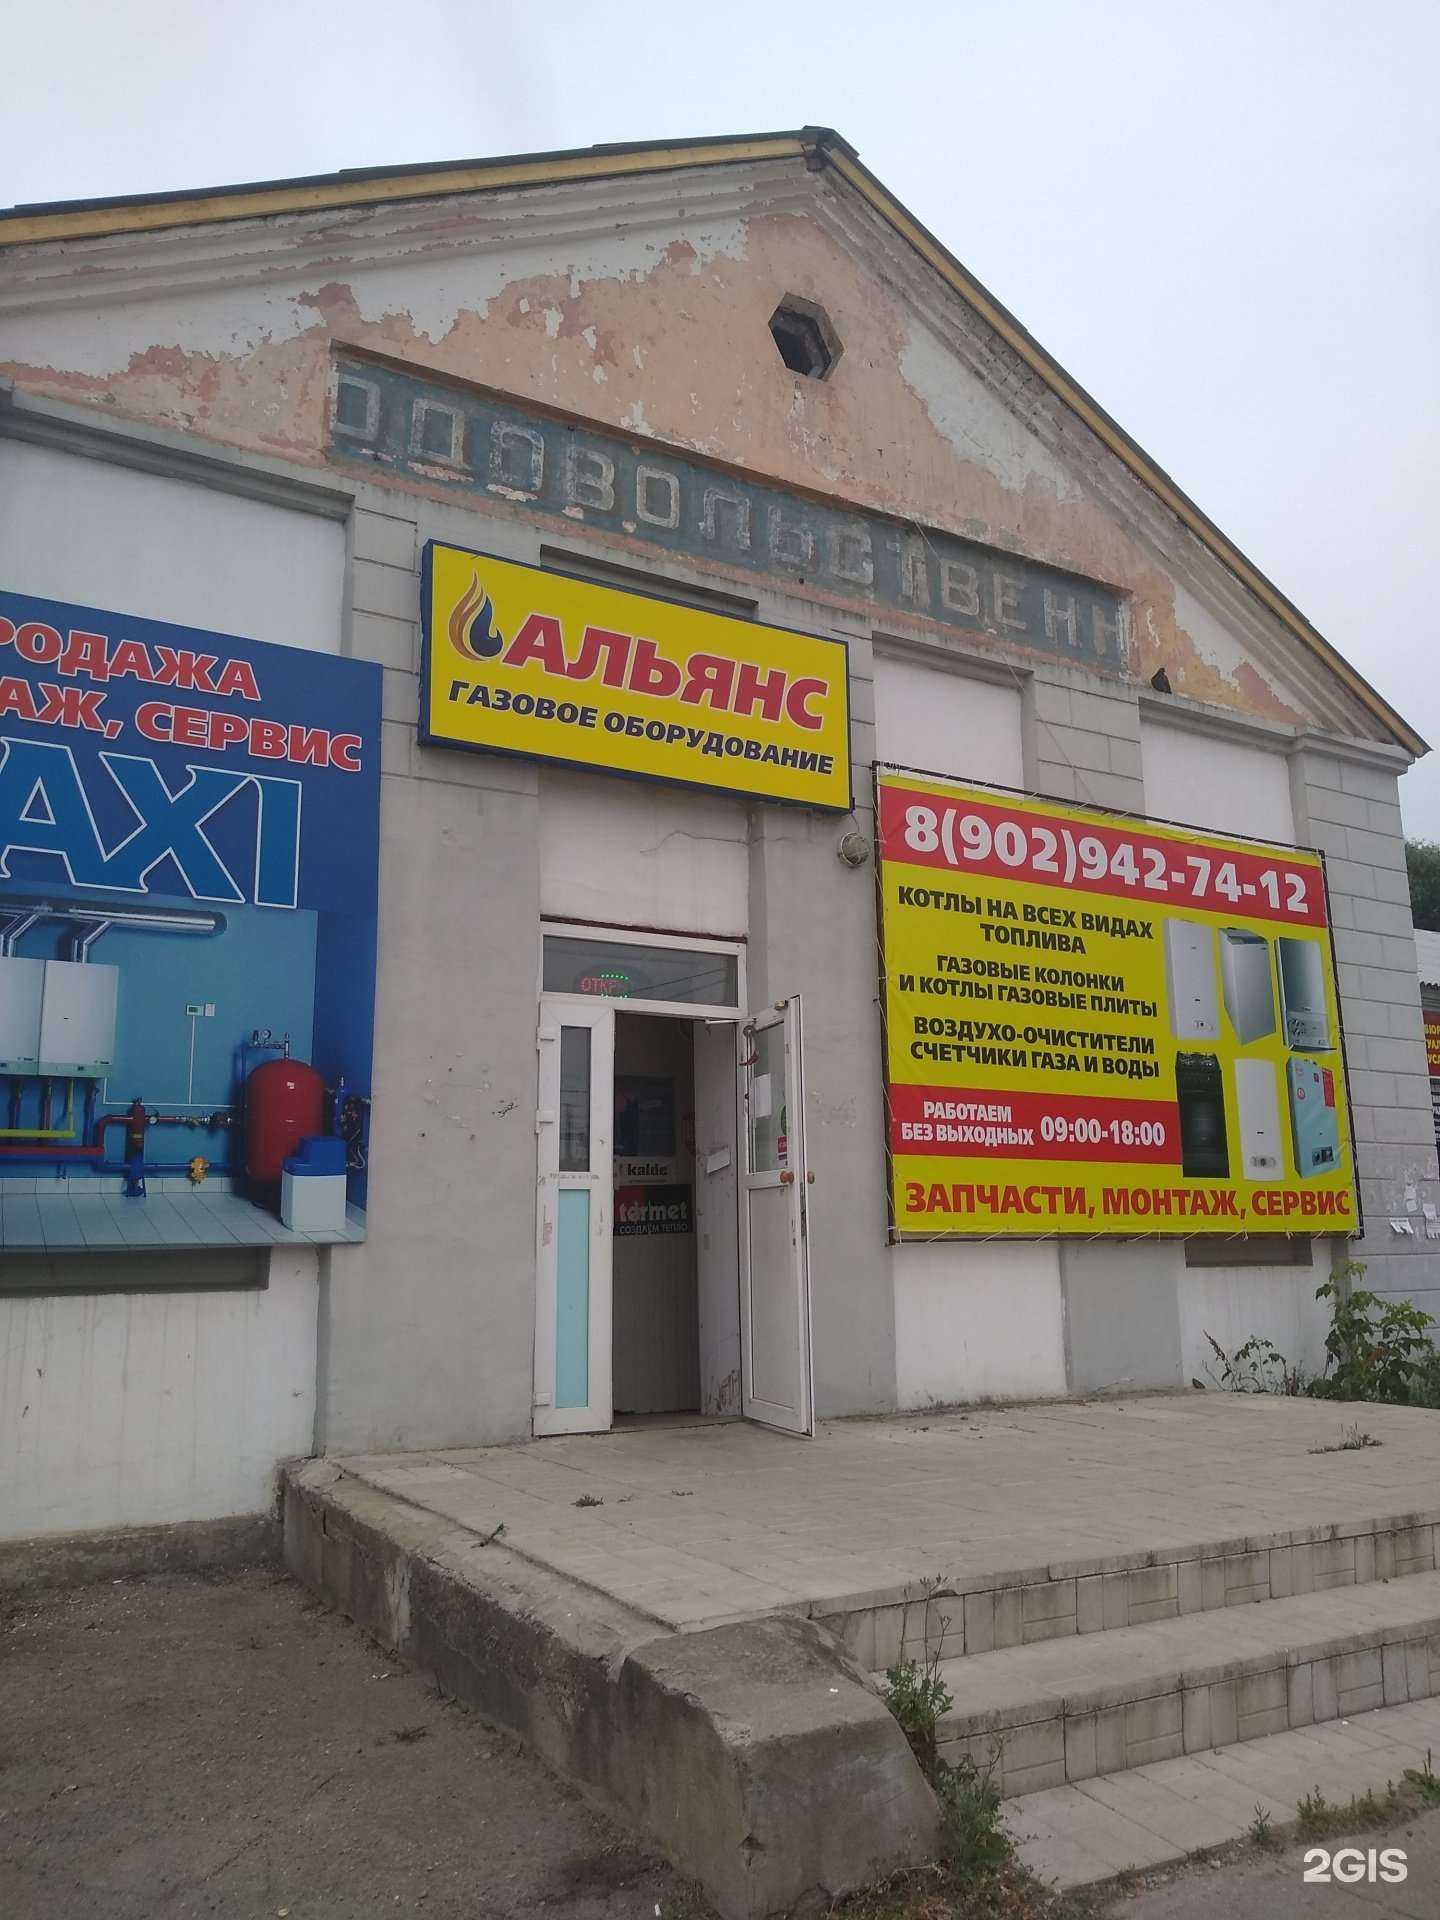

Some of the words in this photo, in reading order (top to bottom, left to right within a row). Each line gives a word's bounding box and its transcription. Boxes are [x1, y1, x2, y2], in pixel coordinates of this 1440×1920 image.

[502, 612, 829, 732] АЛЬЯНС
[134, 701, 362, 772] СЕРВИС
[448, 679, 598, 729] ГАЗОВОЕ
[604, 711, 835, 776] ОБОРУДОВАНИЕ
[903, 804, 1309, 914] 8(902)942-74-12
[897, 885, 982, 915] КОТЛЫ
[987, 894, 1019, 921] НА
[1022, 903, 1077, 930] ВСЕХ
[1081, 914, 1154, 940] ВИДАХ
[979, 922, 1087, 955] ТОПЛИВА
[936, 954, 1030, 983] ГАЗОВЫЕ
[1034, 965, 1125, 993] КОЛОНКИ
[899, 973, 915, 992] И
[919, 974, 994, 1001] КОТЛЫ
[997, 984, 1087, 1010] ГАЗОВЫЕ
[1091, 992, 1158, 1018] ПЛИТЫ
[913, 1015, 1155, 1055] ВОЗДУХО-ОЧИСТИТЕЛИ
[910, 1040, 1024, 1069] СЧЕТЧИКИ
[1030, 1052, 1080, 1075] ГАЗА
[1084, 1056, 1098, 1074] И
[1102, 1058, 1160, 1080] ВОДЫ
[923, 1100, 1012, 1123] РАБОТАЕМ
[1040, 1115, 1166, 1147] 09:00-18:00
[901, 1121, 934, 1142] БЕЗ
[936, 1124, 1034, 1147] ВЫХОДНЫХ
[618, 1202, 688, 1220] termet
[905, 1182, 1095, 1219] ЗАПЧАСТИ,
[1102, 1188, 1246, 1219] МОНТАЖ,
[1251, 1190, 1350, 1216] СЕРВИС
